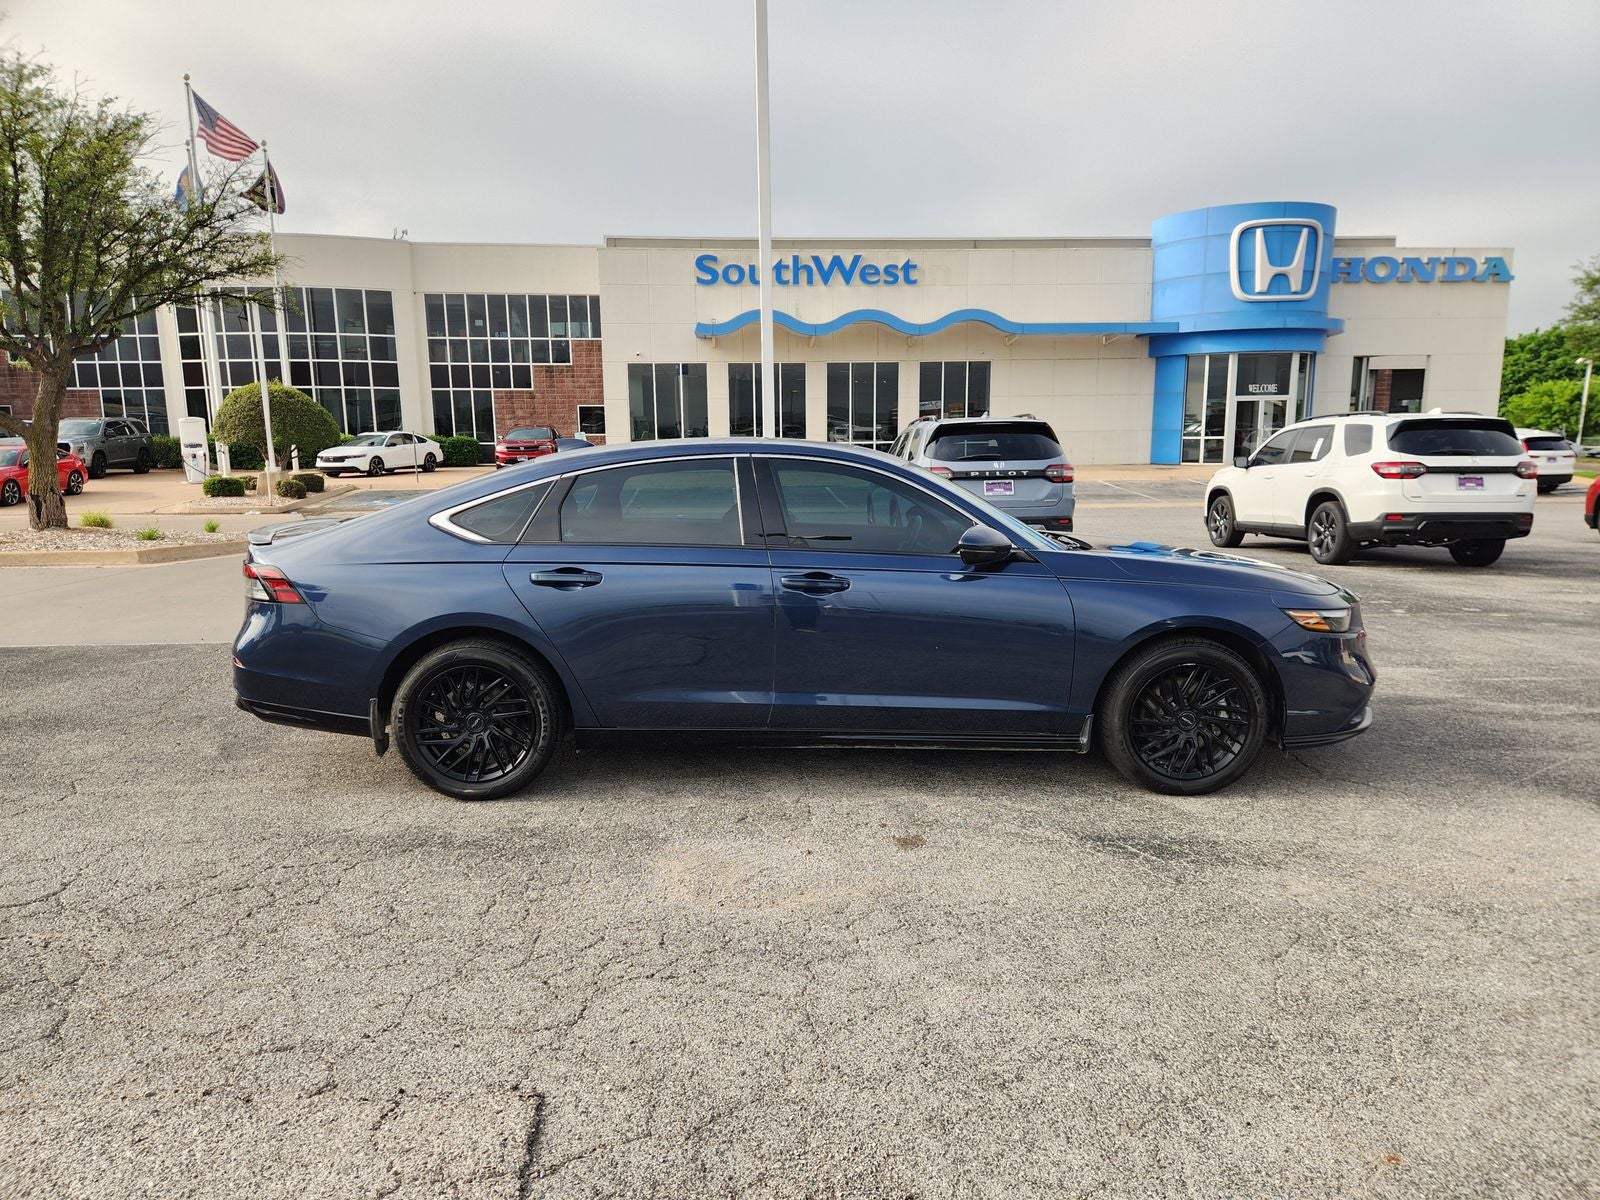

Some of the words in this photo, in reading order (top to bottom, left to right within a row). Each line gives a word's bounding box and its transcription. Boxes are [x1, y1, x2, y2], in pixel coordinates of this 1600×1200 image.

[695, 254, 918, 286] SouthWest
[1331, 256, 1515, 283] HONDA
[1248, 384, 1278, 393] WELCOME
